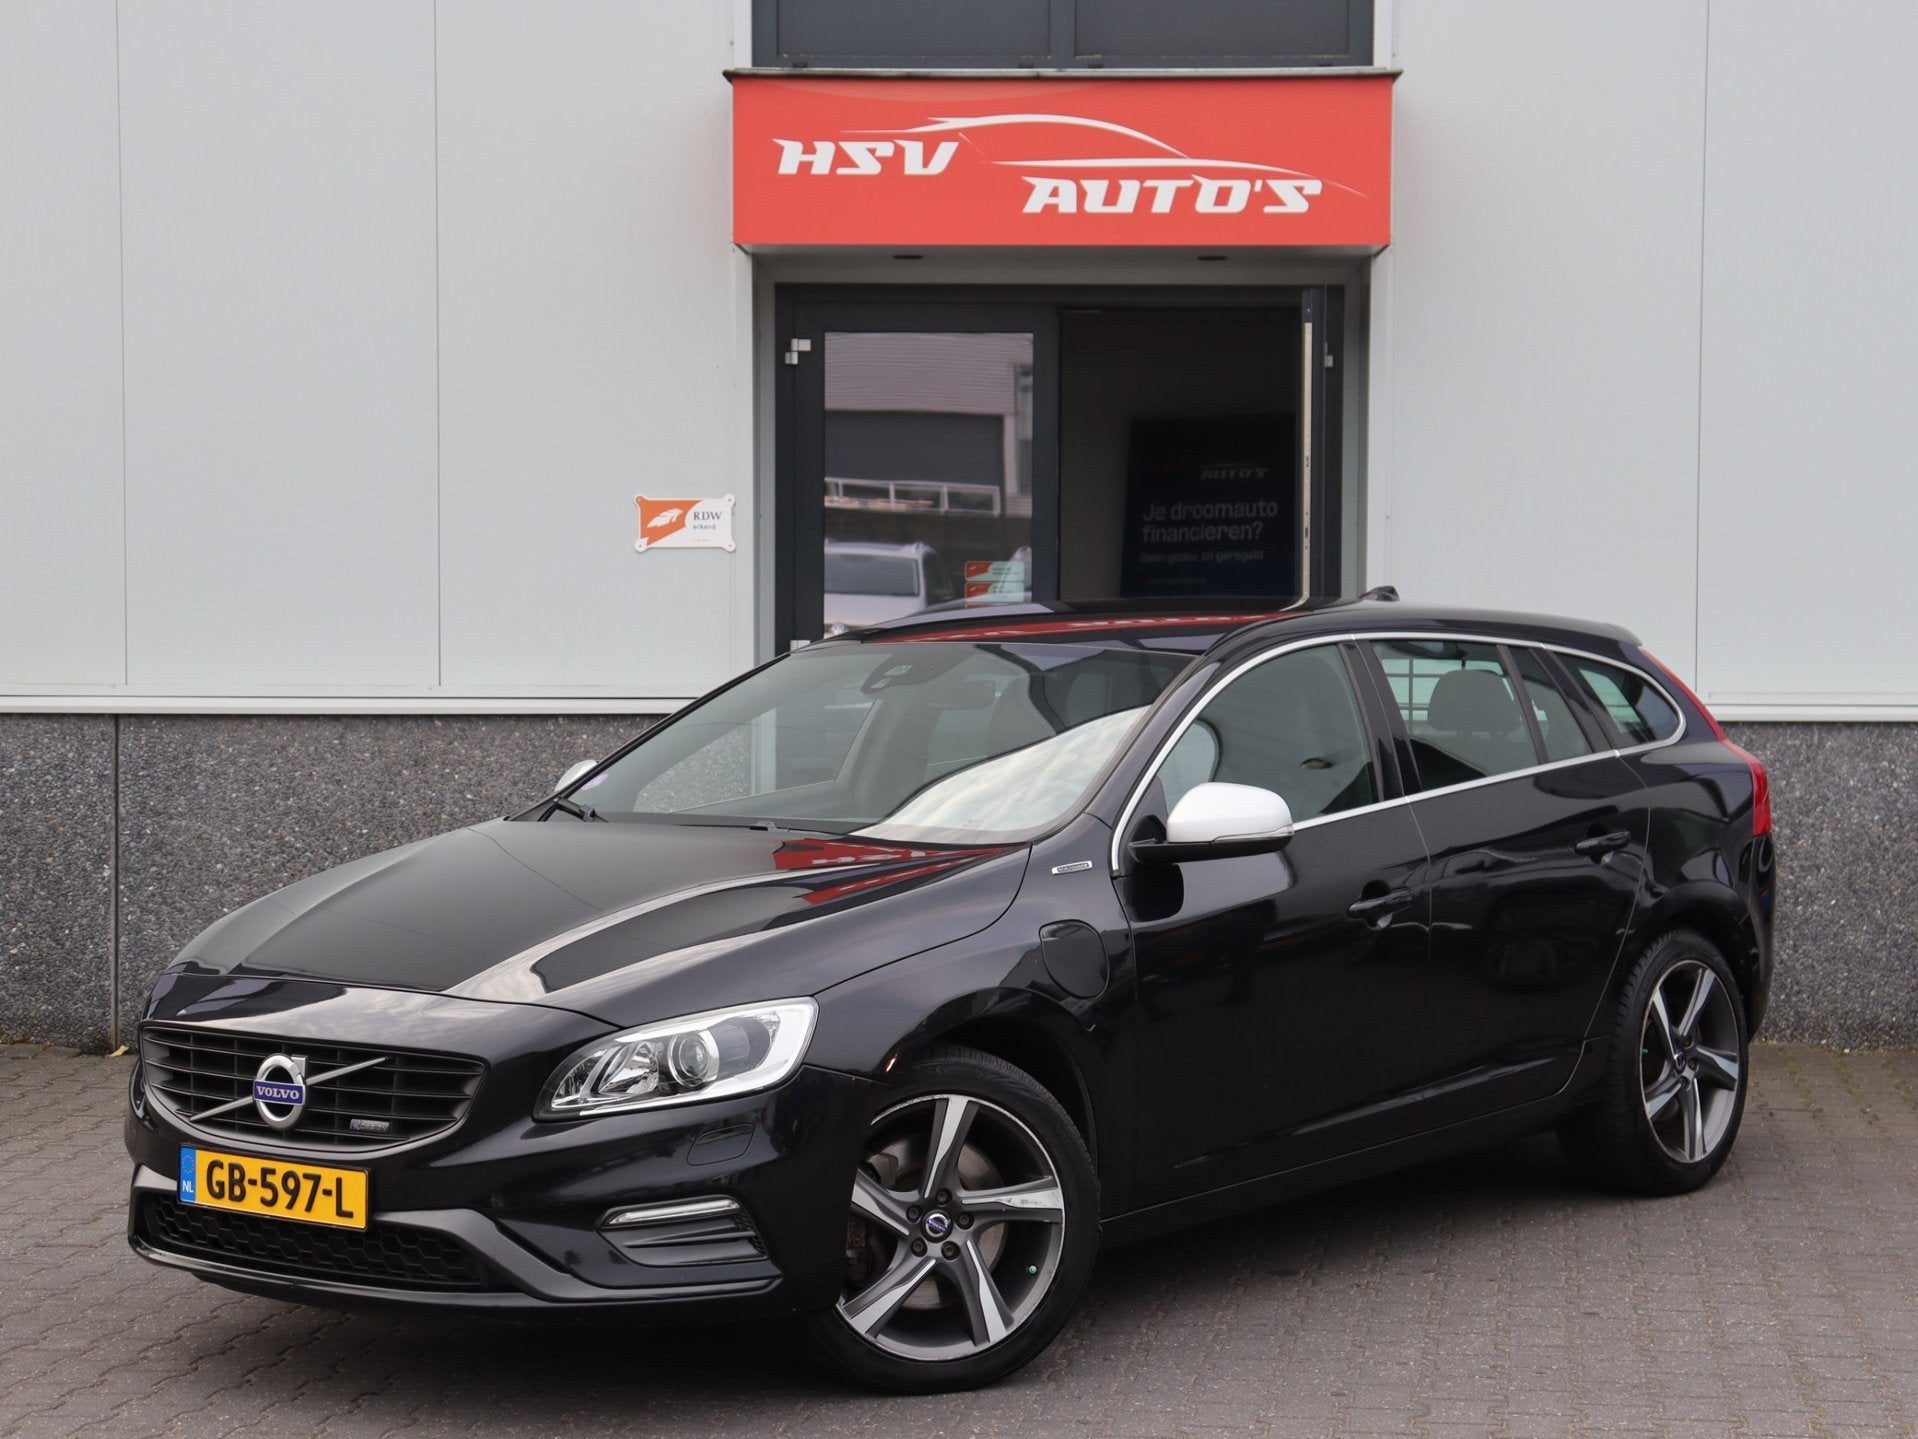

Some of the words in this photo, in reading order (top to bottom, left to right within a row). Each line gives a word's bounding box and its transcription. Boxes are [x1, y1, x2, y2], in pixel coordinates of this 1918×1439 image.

[772, 138, 960, 175] HSV
[1021, 174, 1323, 214] AUTO'S
[693, 511, 722, 521] RDW
[1142, 503, 1166, 521] Je
[1170, 499, 1278, 520] droomauto
[1142, 521, 1264, 543] financieren?
[256, 1085, 300, 1100] VOLVO
[182, 1180, 194, 1194] NL
[206, 1159, 354, 1219] GB-597-L
